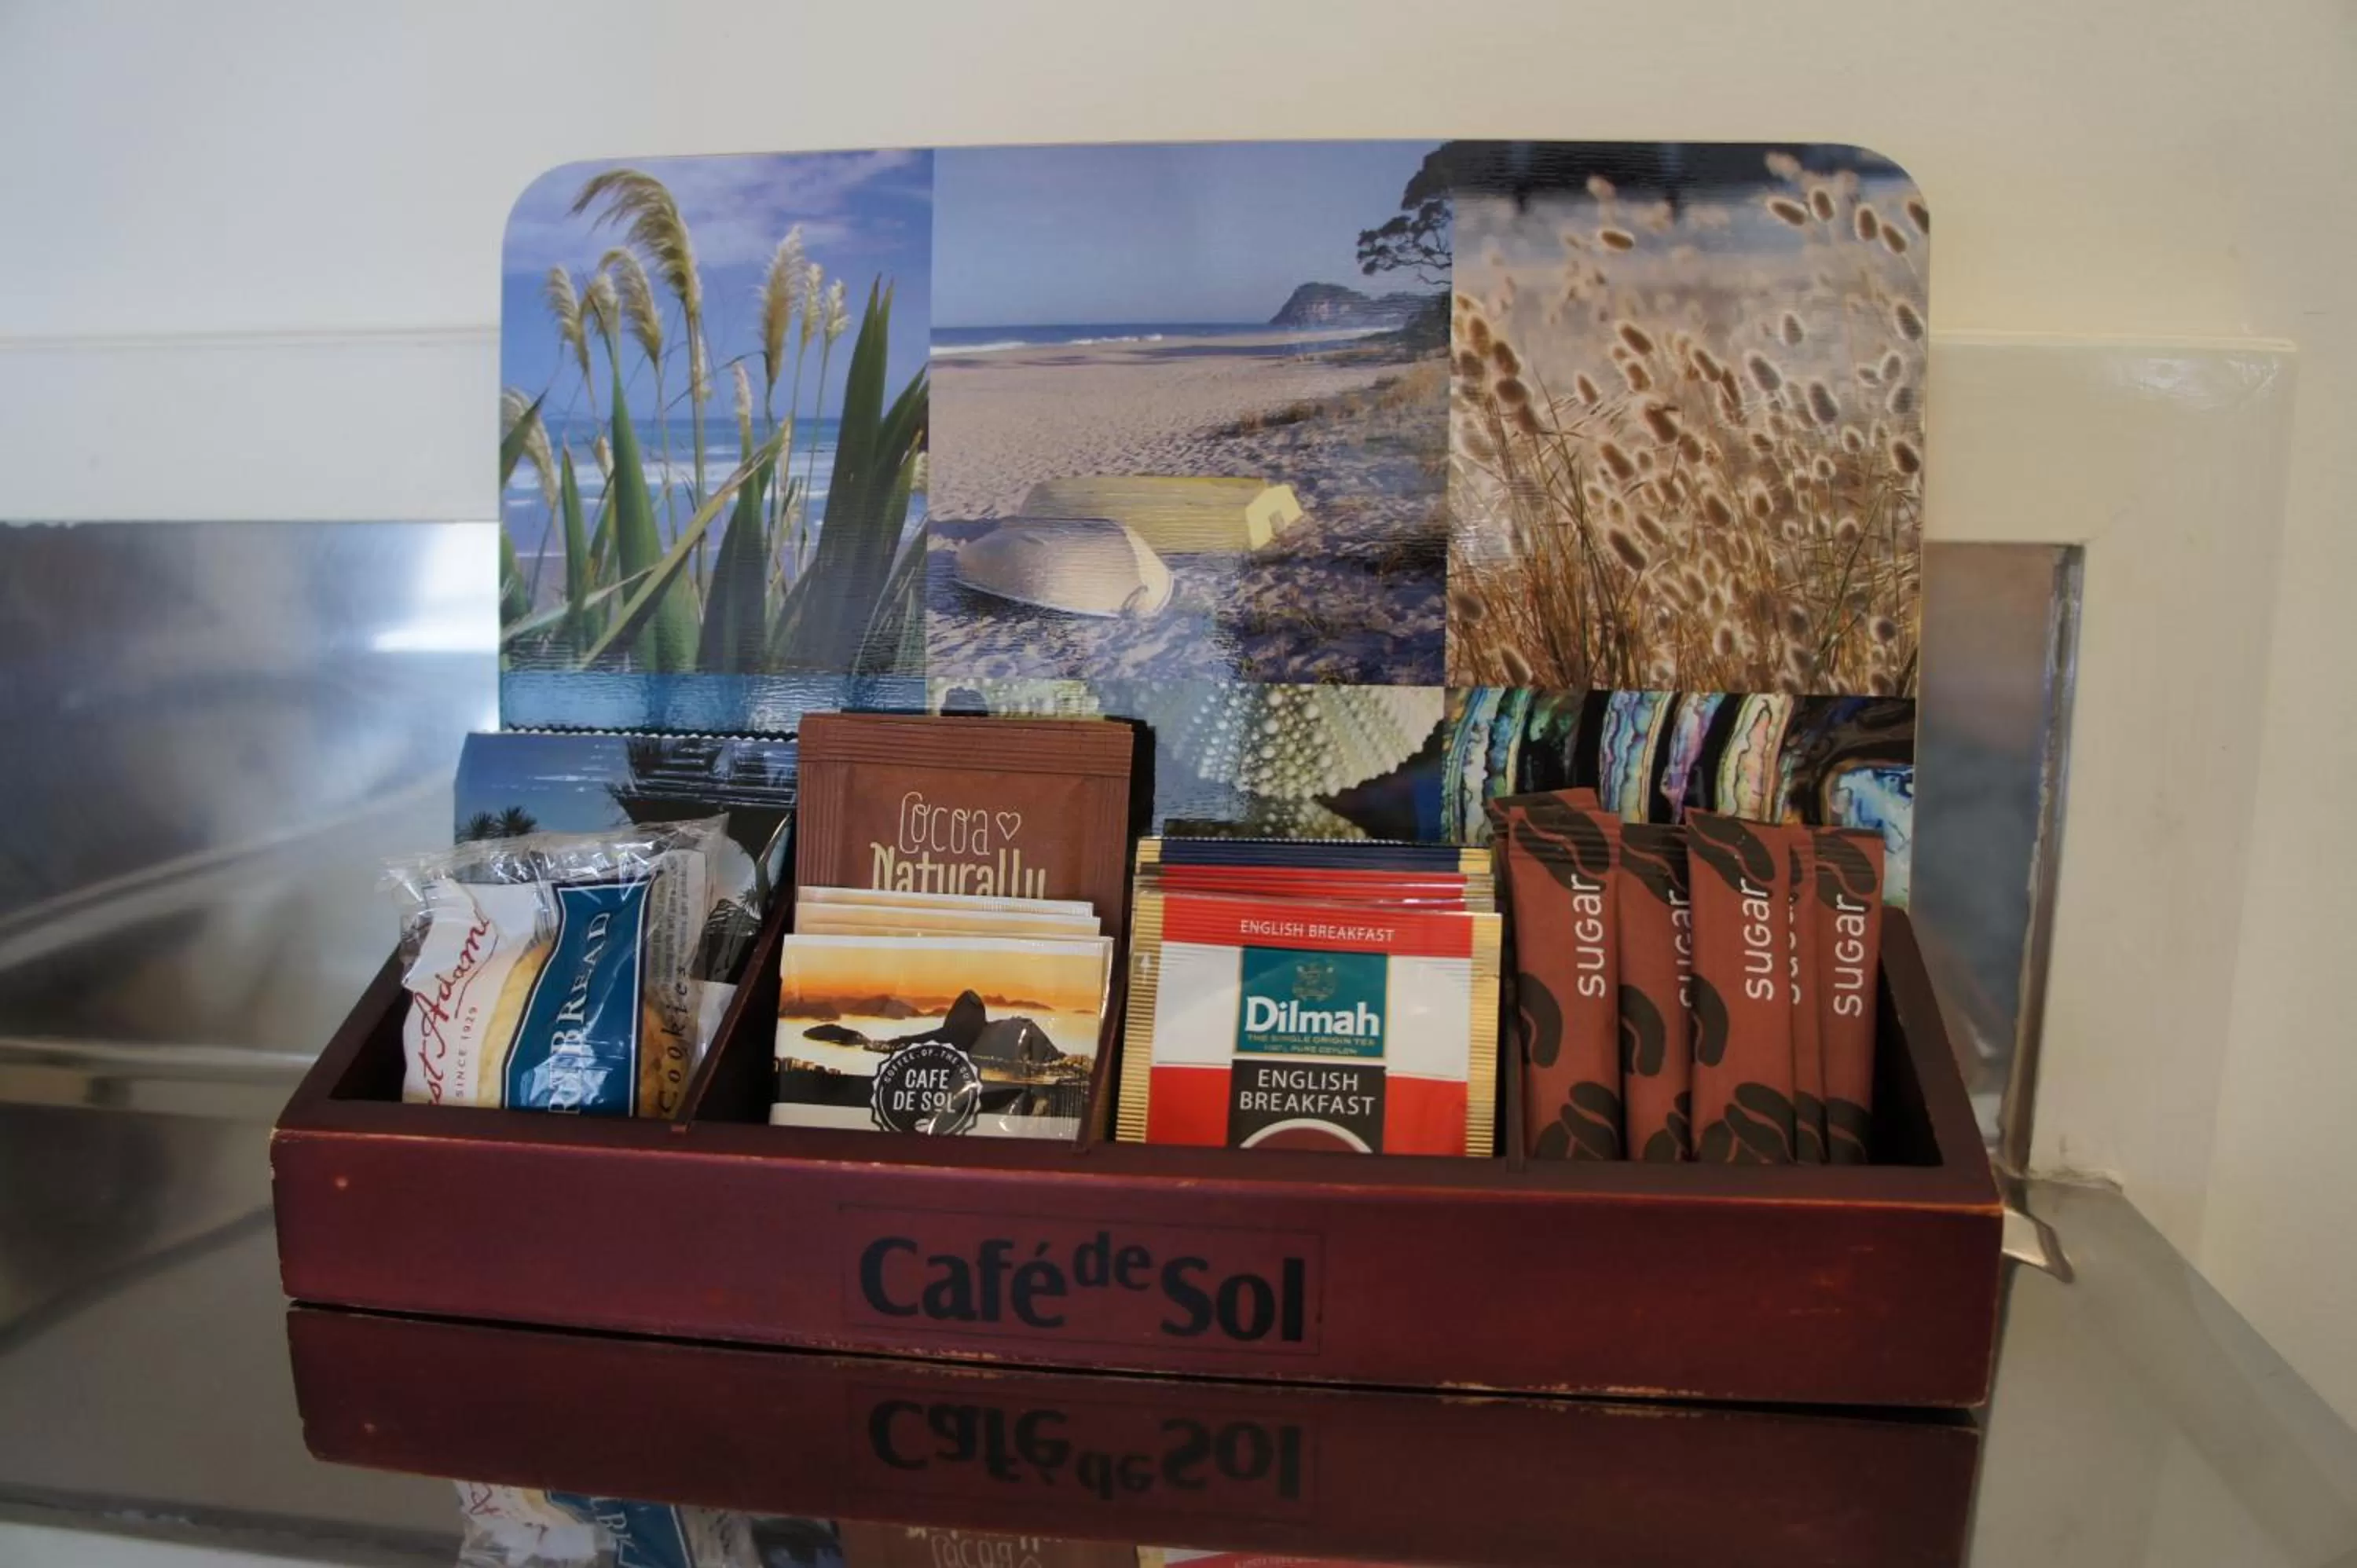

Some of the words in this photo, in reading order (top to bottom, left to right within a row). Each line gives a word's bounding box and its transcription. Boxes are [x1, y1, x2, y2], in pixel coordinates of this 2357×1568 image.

[899, 792, 991, 855] Cocoa
[1240, 920, 1303, 937] ENGLISH
[1309, 924, 1395, 942] BREAKFAST
[1245, 996, 1380, 1037] Dilmah
[456, 1046, 468, 1098] SINCE
[905, 1068, 950, 1089] CAFE
[1257, 1069, 1358, 1091] ENGLISH
[893, 1090, 916, 1112] DE
[921, 1090, 956, 1113] SOL
[1239, 1093, 1376, 1116] BREAKFAST
[859, 1236, 1067, 1328] Café
[1072, 1231, 1153, 1291] de
[1160, 1257, 1306, 1343] Sol
